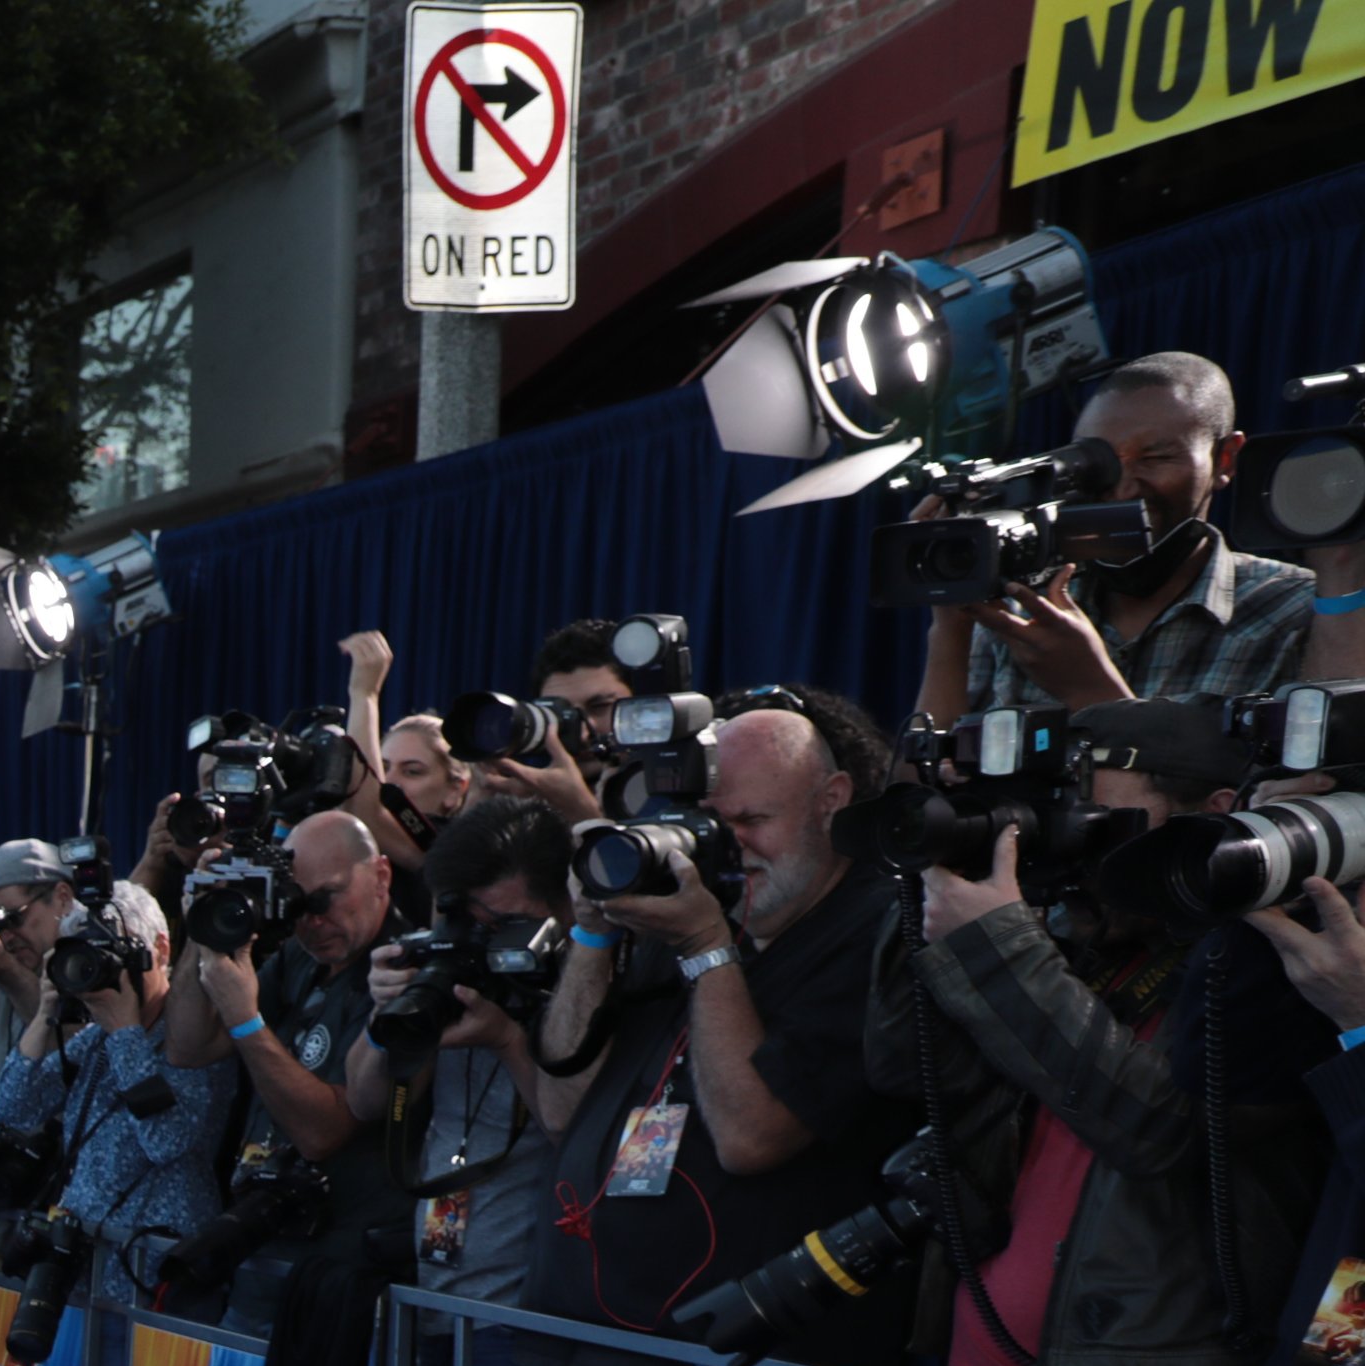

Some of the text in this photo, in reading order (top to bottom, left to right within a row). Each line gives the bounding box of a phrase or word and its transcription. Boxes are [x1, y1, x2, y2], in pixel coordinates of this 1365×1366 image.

[1045, 0, 1322, 154] NOW
[423, 234, 555, 277] ON RED
[393, 1085, 408, 1122] Nikon
